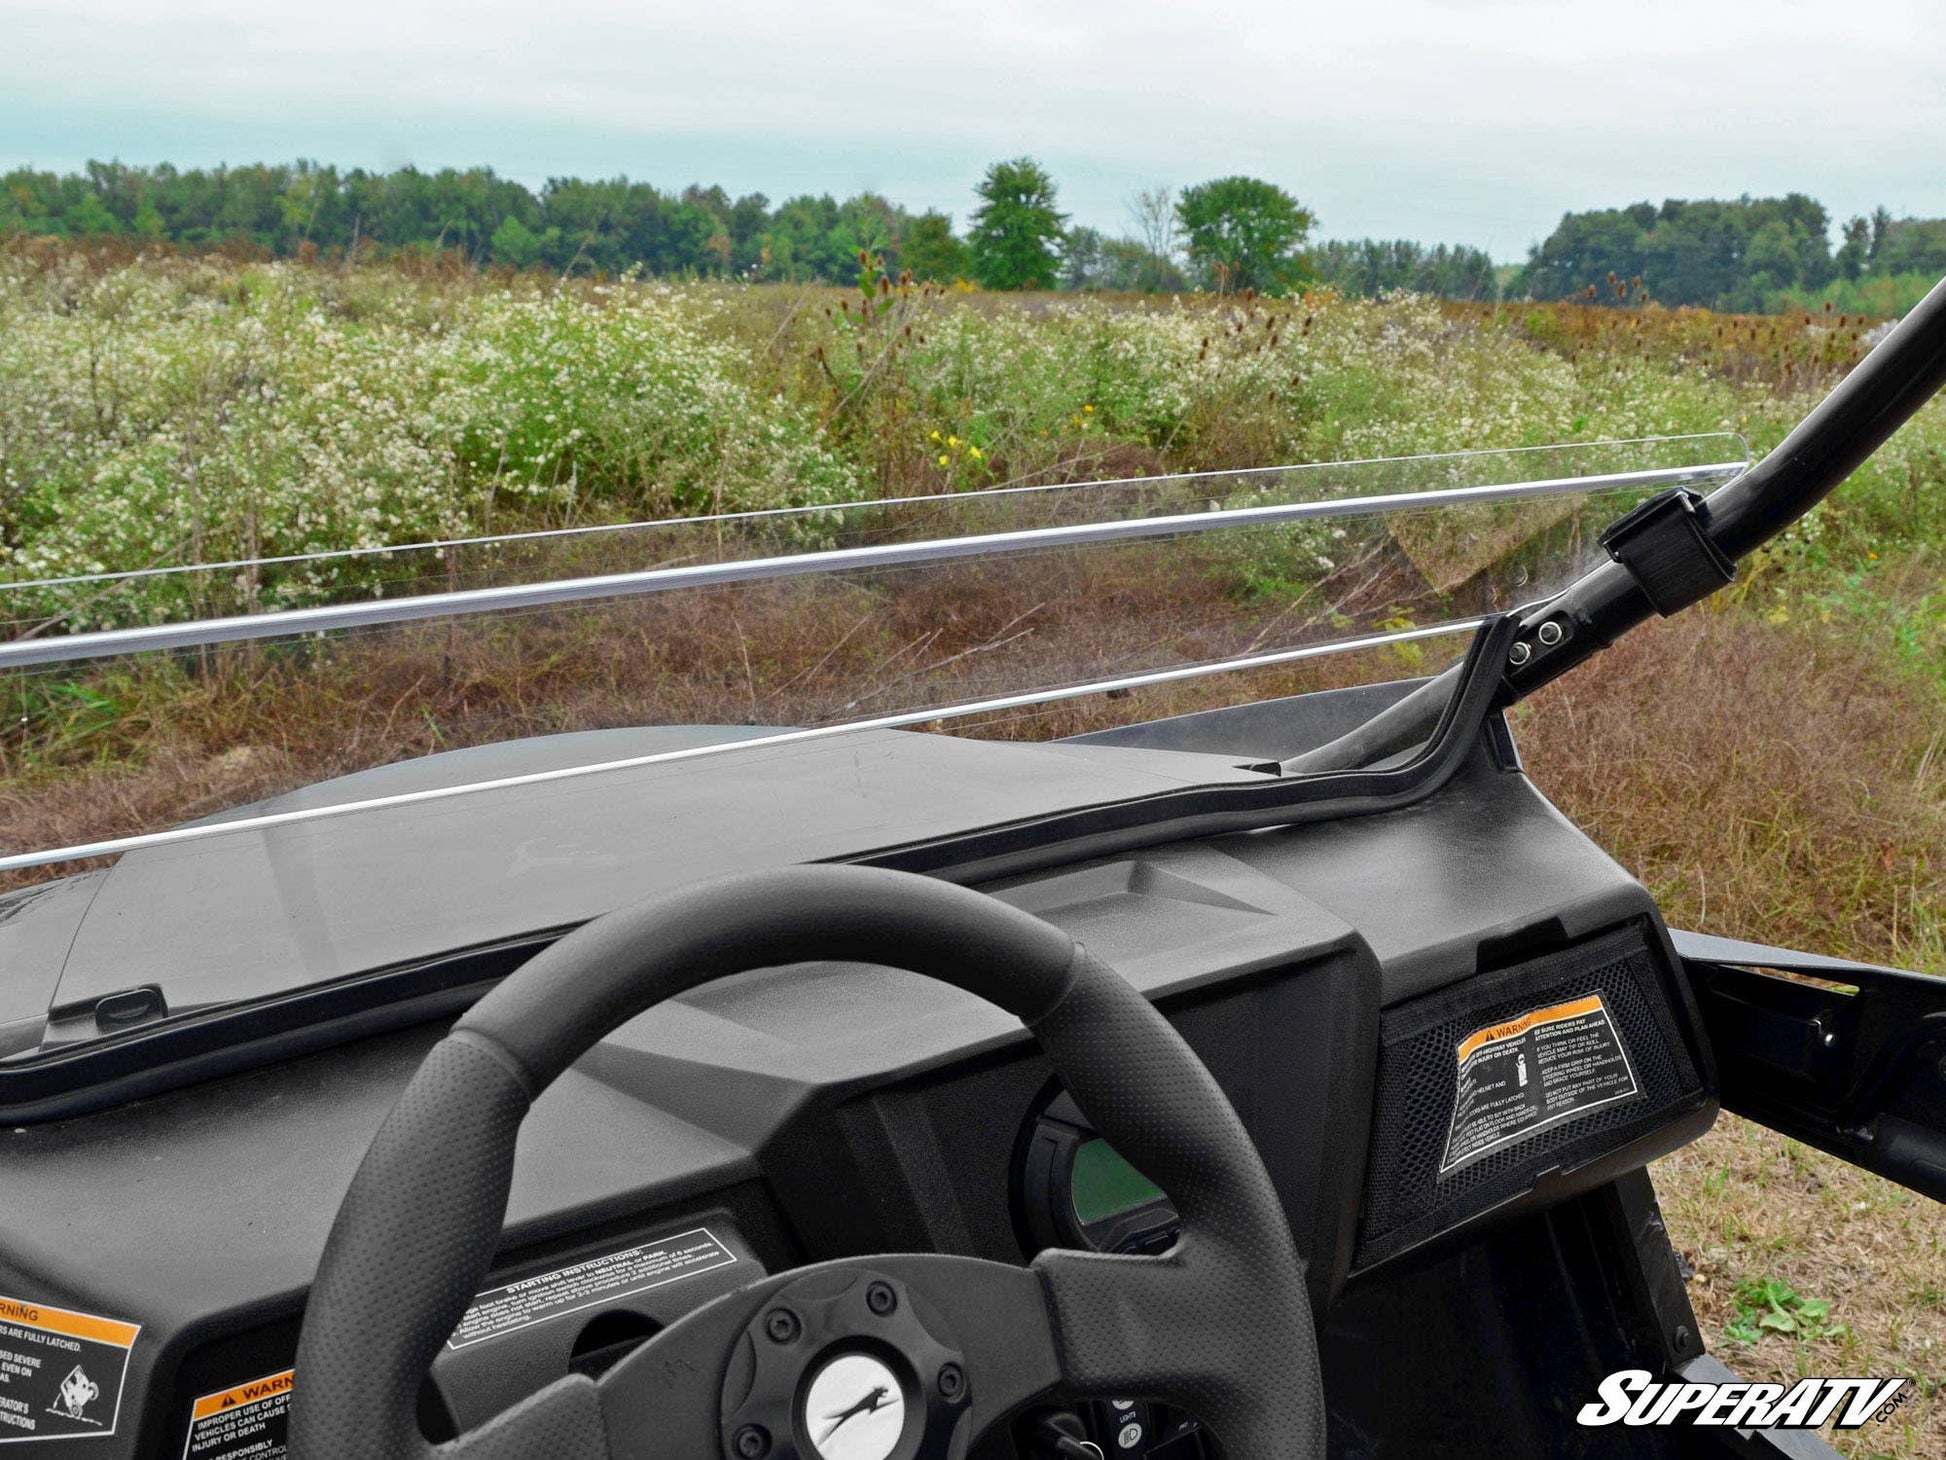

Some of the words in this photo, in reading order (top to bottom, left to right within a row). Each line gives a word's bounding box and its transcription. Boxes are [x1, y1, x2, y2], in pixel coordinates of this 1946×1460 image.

[1496, 1017, 1532, 1038] WARNING
[1535, 1031, 1562, 1041] ATTENTION
[506, 1274, 561, 1294] STARTING
[562, 1249, 643, 1277] INSTRUCTIONS:
[595, 1260, 634, 1275] NEUTRAL
[8, 1328, 22, 1339] ARE
[23, 1331, 47, 1344] FULLY
[2, 1362, 21, 1375] EVEN
[21, 1367, 33, 1378] ON
[13, 1354, 41, 1369] SEVERE
[195, 1422, 236, 1441] VEHICLES
[237, 1416, 256, 1426] CAN
[257, 1406, 285, 1420] CAUSE
[198, 1410, 242, 1430] IMPROPER
[243, 1404, 260, 1415] USE
[261, 1400, 274, 1409] OF
[192, 1437, 221, 1452] INJURY
[223, 1432, 237, 1442] OR
[238, 1422, 266, 1437] DEATH
